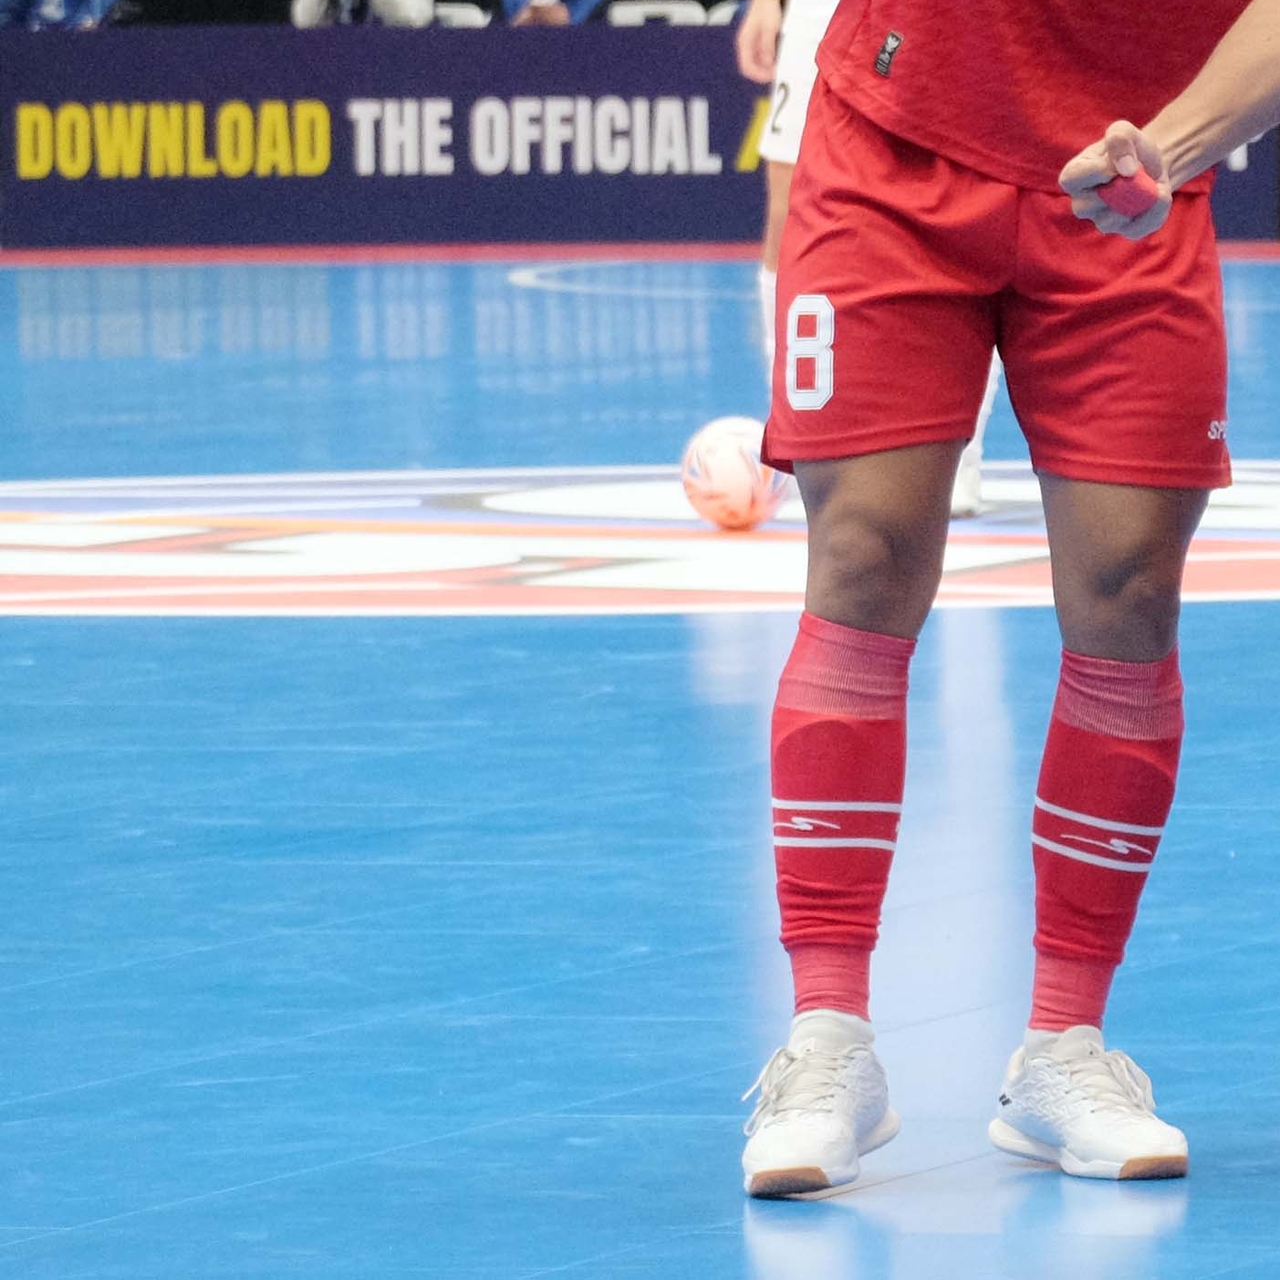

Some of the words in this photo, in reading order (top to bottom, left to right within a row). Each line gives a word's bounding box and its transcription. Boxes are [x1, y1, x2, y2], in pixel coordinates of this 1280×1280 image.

[15, 99, 332, 181] DOWNLOAD
[346, 97, 456, 177] THE
[468, 94, 723, 176] OFFICIAL
[785, 293, 836, 411] 8
